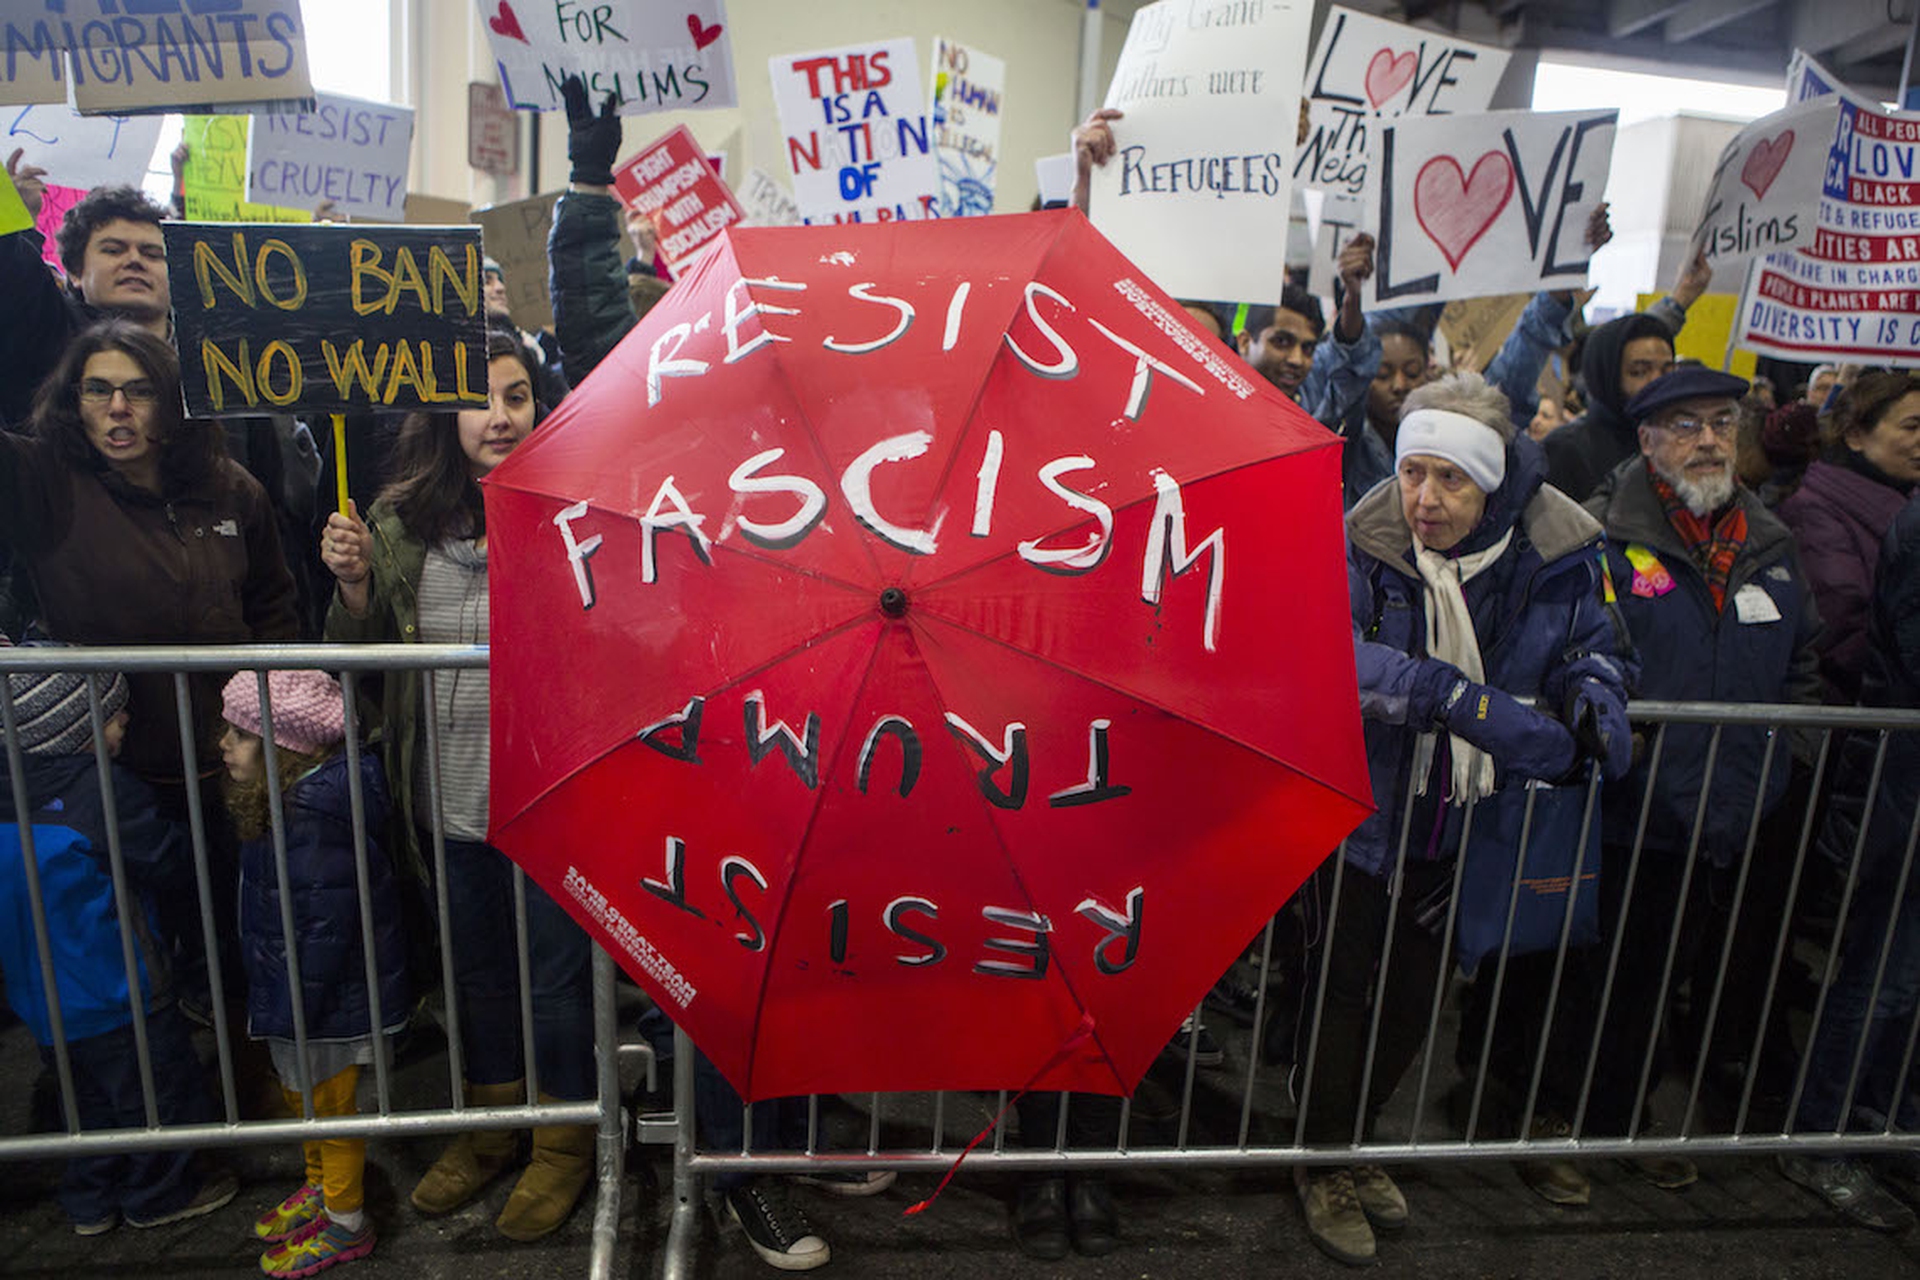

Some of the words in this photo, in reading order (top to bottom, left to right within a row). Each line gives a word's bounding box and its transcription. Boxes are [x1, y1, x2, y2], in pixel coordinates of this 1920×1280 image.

[556, 1, 629, 44] FOR
[792, 51, 892, 99] THIS
[940, 40, 968, 75] NO
[1209, 69, 1264, 95] were
[822, 93, 851, 125] IS
[863, 91, 889, 118] A
[1858, 112, 1878, 134] ALL
[1886, 122, 1920, 141] PEO
[631, 146, 675, 187] FIGHT
[788, 116, 929, 174] NATION
[260, 160, 402, 207] CRUELTY
[632, 158, 707, 214] TRUMPISM
[839, 162, 881, 201] OF
[1853, 182, 1912, 204] BLACK
[662, 202, 736, 259] SOCIALISM
[664, 191, 704, 226] WITH
[1811, 232, 1871, 260] ITIES
[194, 233, 307, 310] NO
[350, 239, 478, 315] BAN
[1831, 268, 1847, 284] IN
[1750, 301, 1861, 342] DIVERSITY
[1877, 318, 1898, 344] IS
[1810, 291, 1869, 310] PLANET
[1878, 293, 1908, 311] ARE
[648, 276, 1204, 420] RESIST
[202, 338, 302, 411] NO
[321, 338, 488, 405] WALL
[554, 430, 1224, 652] FASCISM
[638, 689, 1132, 809] TRUMP
[640, 837, 1144, 979] RESIST
[567, 866, 609, 907] SAME
[608, 906, 656, 954] GREAT
[655, 953, 697, 996] TEAM
[605, 923, 662, 982] DECEMBER
